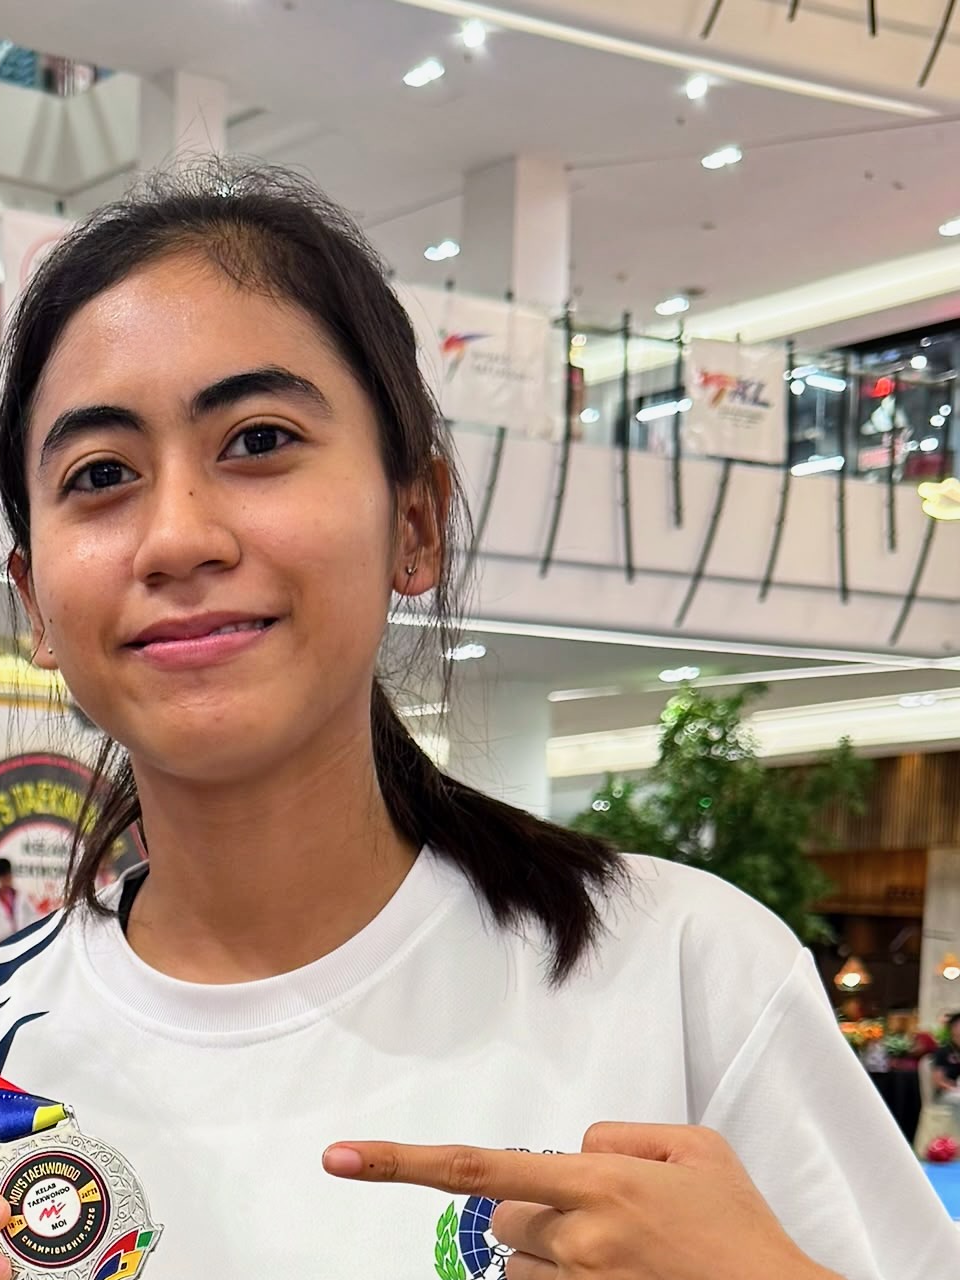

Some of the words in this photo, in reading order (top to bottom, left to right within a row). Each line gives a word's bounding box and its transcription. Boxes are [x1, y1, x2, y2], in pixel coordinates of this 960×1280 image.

[8, 1176, 28, 1206] MOI'S
[22, 1161, 81, 1182] TAEKWONDO
[27, 1186, 70, 1208] TAEKWONDO
[51, 1219, 67, 1231] MOI
